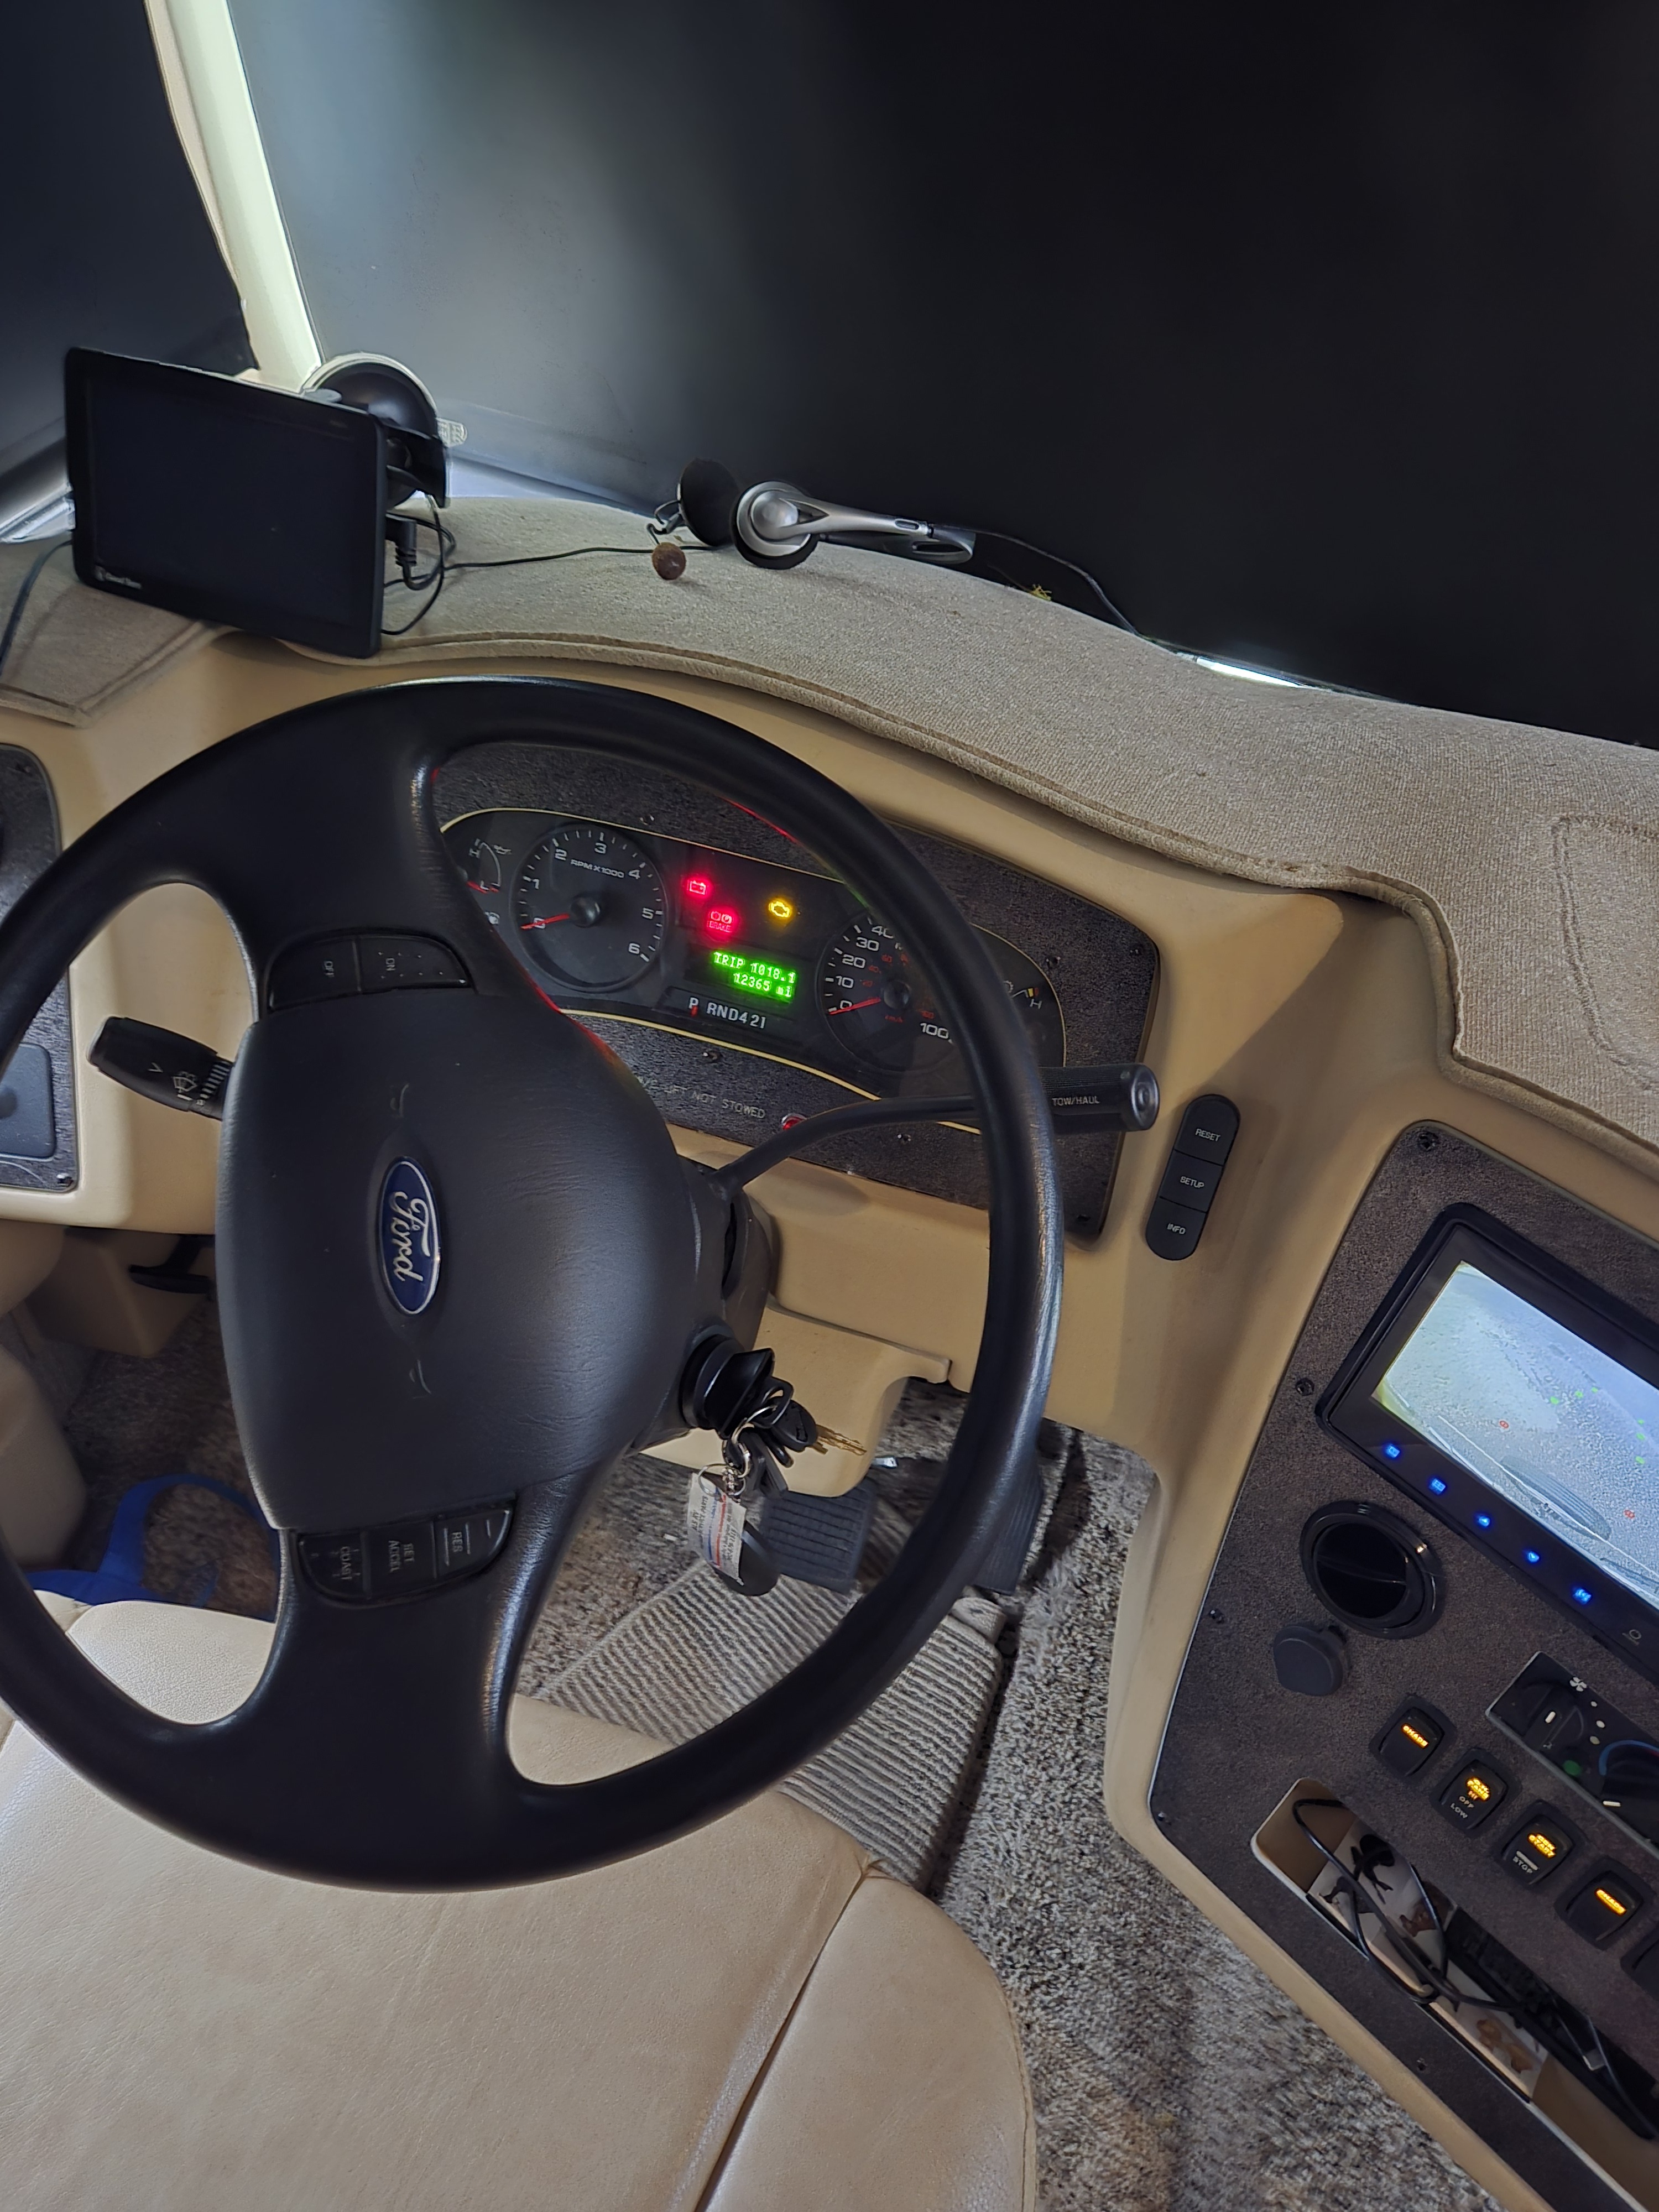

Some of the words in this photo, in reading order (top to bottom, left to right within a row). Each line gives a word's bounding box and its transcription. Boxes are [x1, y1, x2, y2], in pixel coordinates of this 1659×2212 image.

[594, 842, 607, 854] 3
[555, 849, 567, 861] 2
[570, 858, 592, 870] RPM
[629, 869, 641, 880] 4
[531, 878, 540, 890] 1
[642, 907, 654, 920] 5
[709, 920, 732, 933] BRAKE
[628, 942, 640, 954] 6
[855, 937, 880, 952] 30
[385, 957, 397, 972] ON
[713, 951, 745, 969] TRIP
[750, 962, 796, 984] 1018.1
[842, 954, 866, 969] 20
[733, 972, 772, 992] 12365
[775, 985, 792, 998] mi
[836, 975, 854, 989] 10
[688, 997, 700, 1010] P
[839, 1000, 853, 1011] 0
[1030, 998, 1042, 1010] H
[920, 1022, 950, 1040] 100
[1051, 1095, 1100, 1107] TOW/HAUL
[721, 1098, 766, 1119] STOWED
[1194, 1128, 1221, 1142] RESET
[1180, 1176, 1205, 1189] SETUP
[1167, 1223, 1186, 1235] INFO
[390, 1191, 431, 1282] Ford
[1459, 1796, 1475, 1808] OFF
[1450, 1802, 1468, 1819] LOW
[1512, 1855, 1533, 1874] STOP
